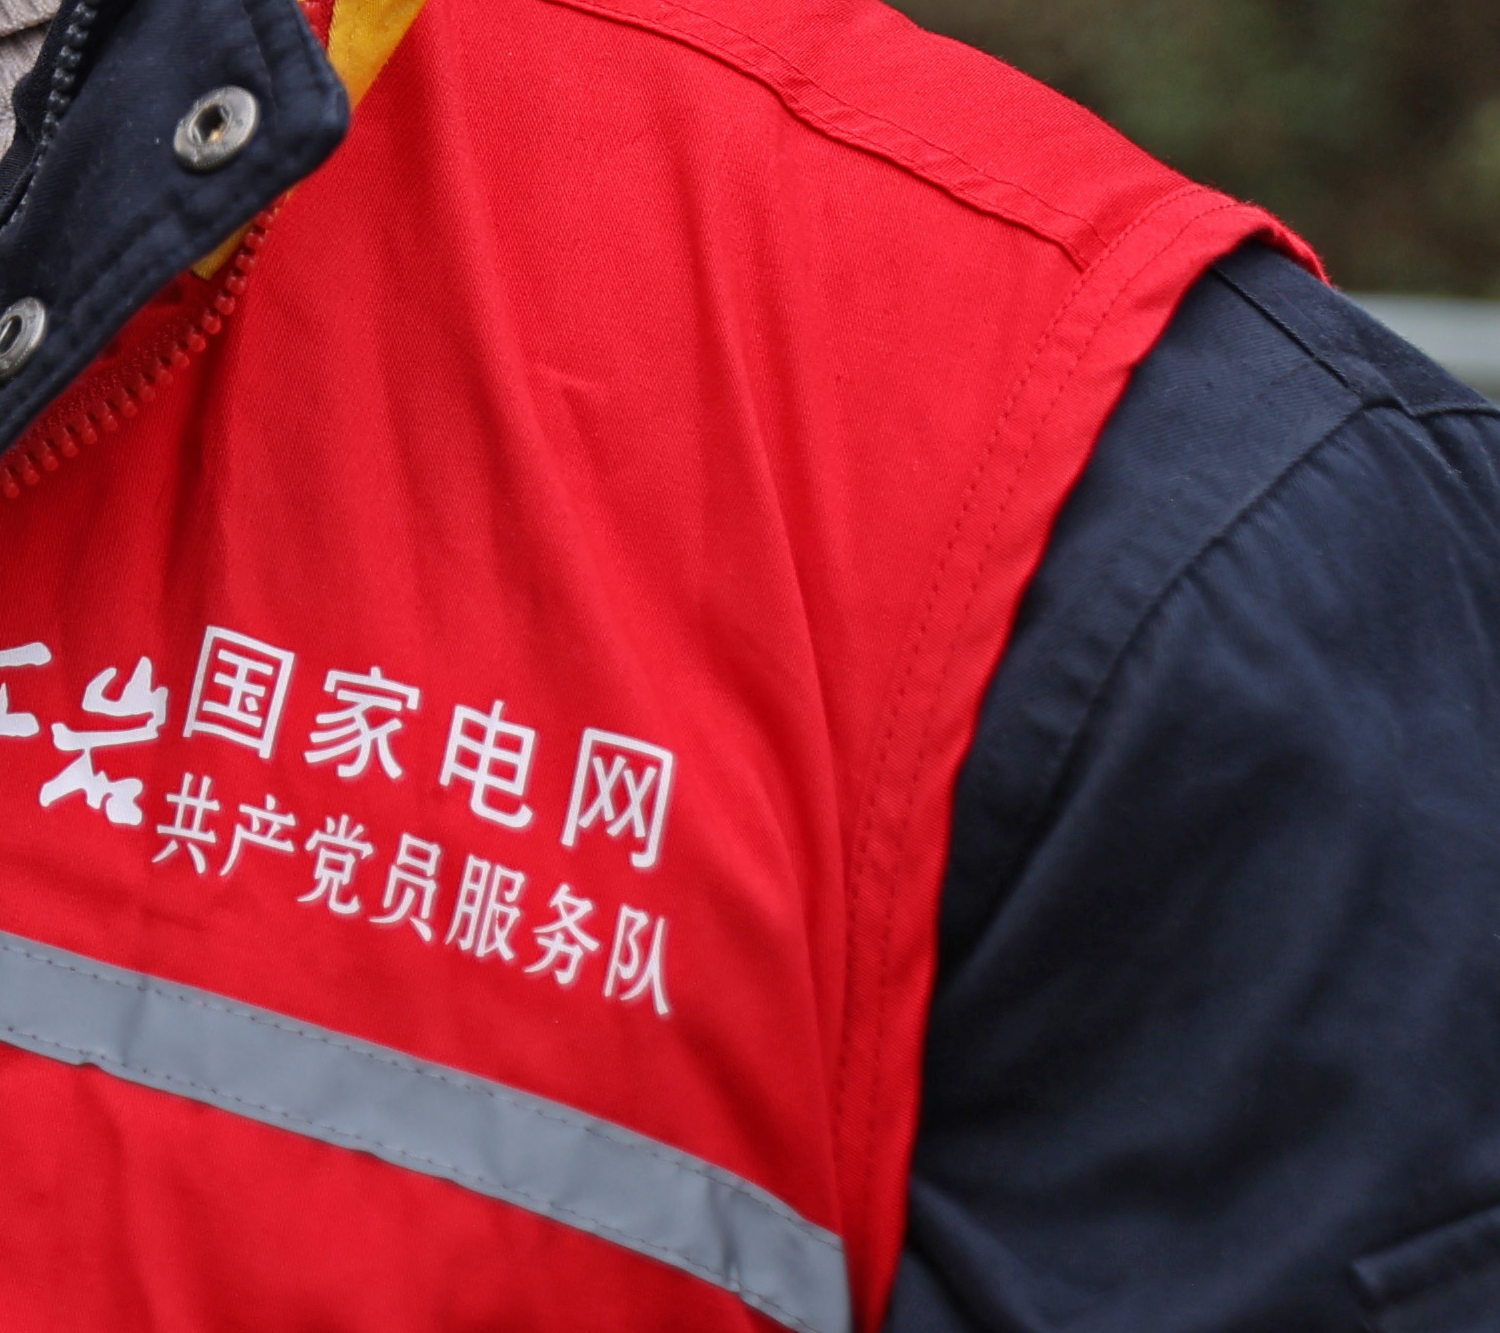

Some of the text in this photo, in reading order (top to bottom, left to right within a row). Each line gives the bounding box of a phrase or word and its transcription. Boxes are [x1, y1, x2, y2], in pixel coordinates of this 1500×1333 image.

[180, 624, 675, 870] 国家电网
[151, 771, 671, 1017] 共产党员服务队
